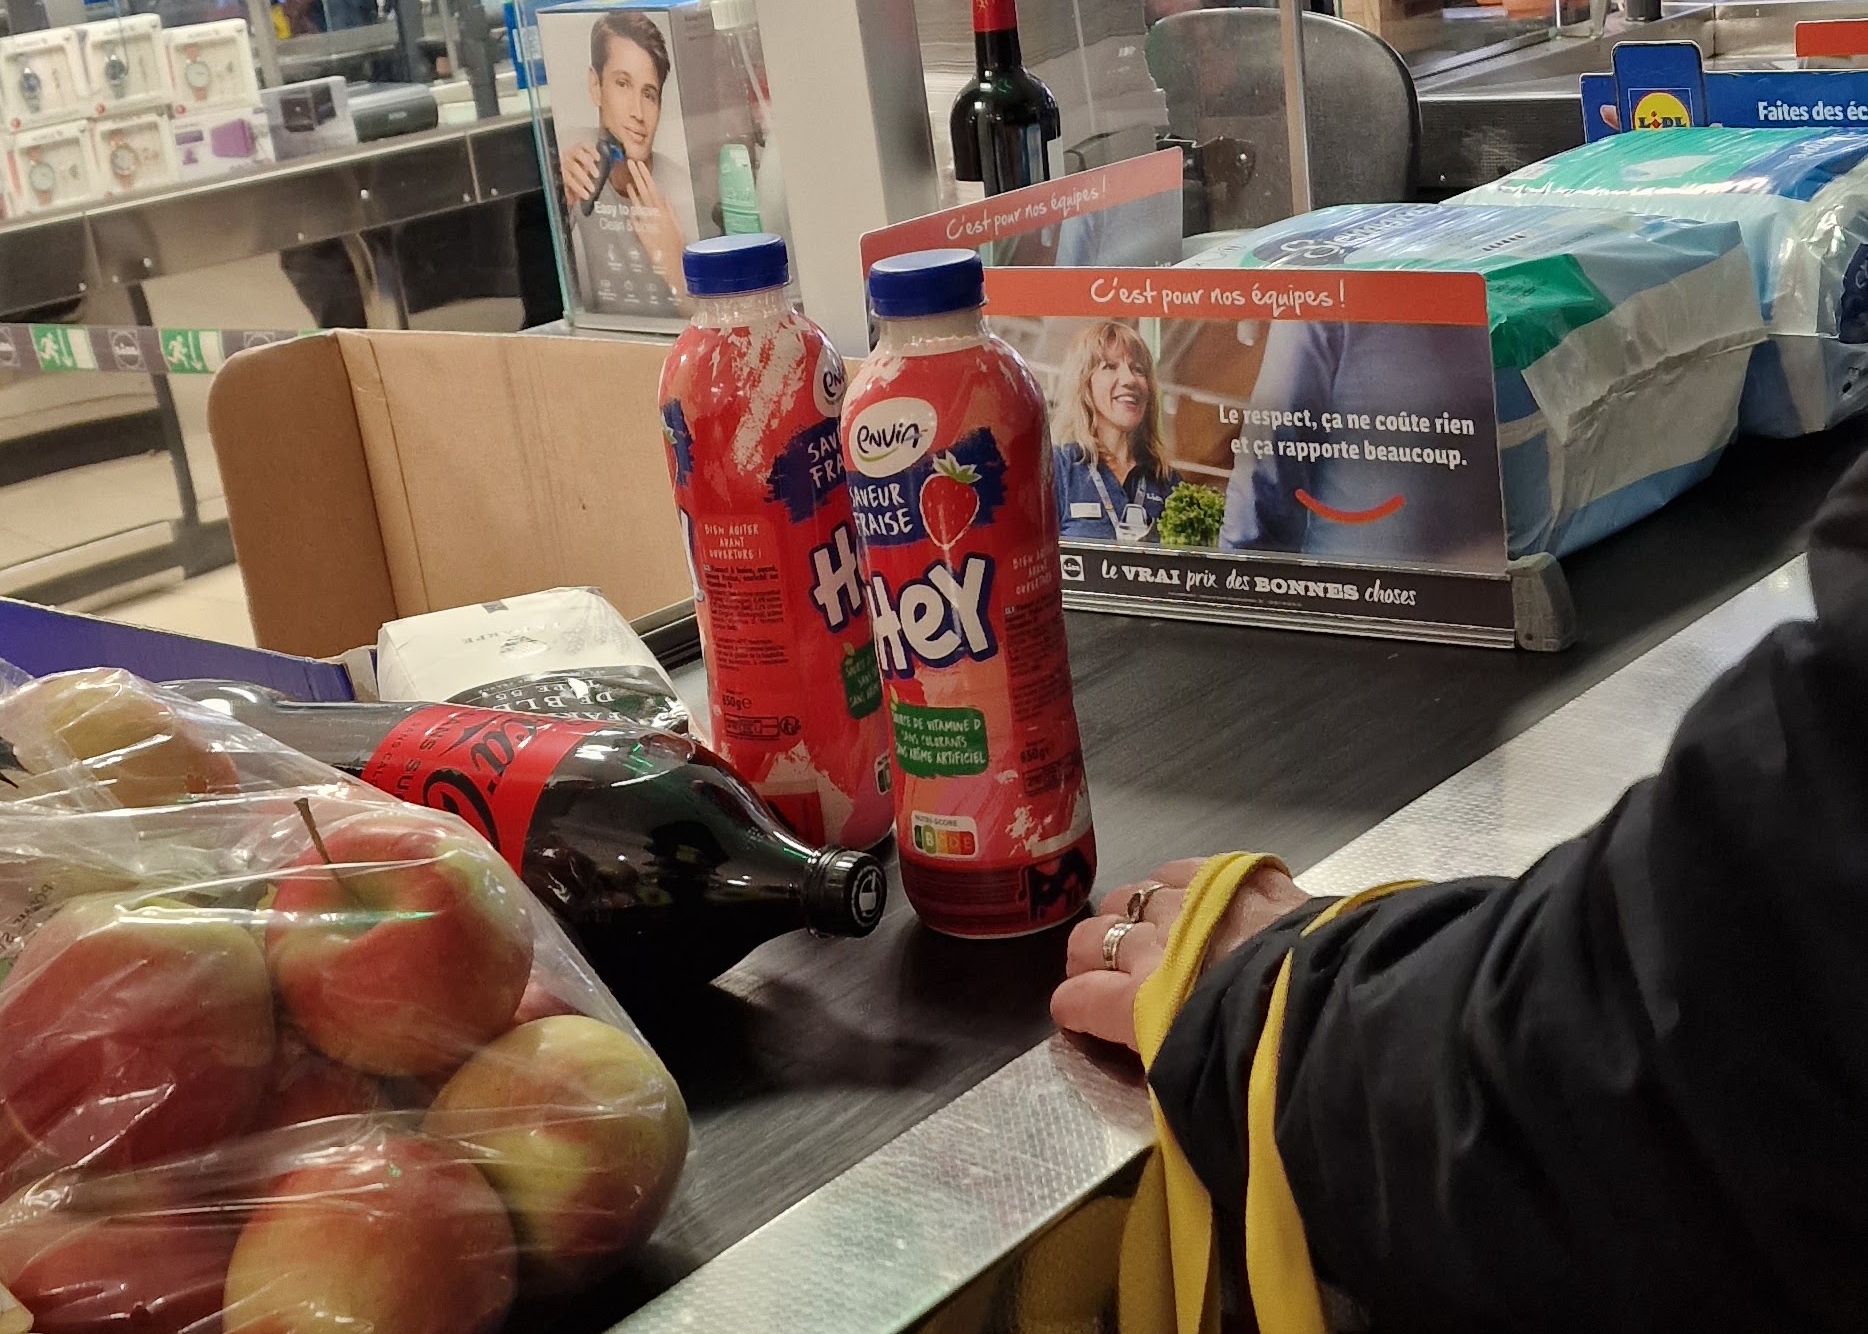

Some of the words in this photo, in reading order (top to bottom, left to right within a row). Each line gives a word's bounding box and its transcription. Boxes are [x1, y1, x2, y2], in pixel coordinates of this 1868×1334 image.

[1757, 100, 1808, 121] Faites
[1812, 100, 1844, 121] des
[618, 203, 629, 215] to
[946, 208, 992, 241] C'est
[993, 209, 1021, 236] pour
[1025, 202, 1047, 219] nos
[1051, 186, 1099, 217] équipes
[1090, 277, 1157, 304] C'est
[1162, 288, 1204, 314] pour
[1210, 288, 1246, 306] nos
[1252, 282, 1333, 316] équipes
[1219, 404, 1238, 424] Le
[1243, 409, 1317, 430] respect,
[1321, 412, 1343, 433] ça
[1347, 414, 1371, 430] ne
[1375, 411, 1430, 434] coûte
[1435, 412, 1475, 435] rien
[1231, 438, 1249, 454] et
[1253, 439, 1274, 460] ça
[1277, 440, 1360, 462] rapporte
[1363, 440, 1468, 470] beaucoup.
[850, 482, 905, 508] SAVEUR
[853, 508, 913, 536] FRAISE
[1121, 565, 1180, 585] VRAI
[1186, 569, 1218, 591] prix
[1226, 568, 1250, 591] des
[1254, 576, 1360, 601] BONNES
[1365, 578, 1417, 606] choses
[913, 718, 923, 728] DE
[927, 718, 969, 731] VITAMINE
[974, 719, 981, 730] D
[921, 735, 967, 747] COLORANTS
[936, 750, 986, 764] ARTIFICIEL
